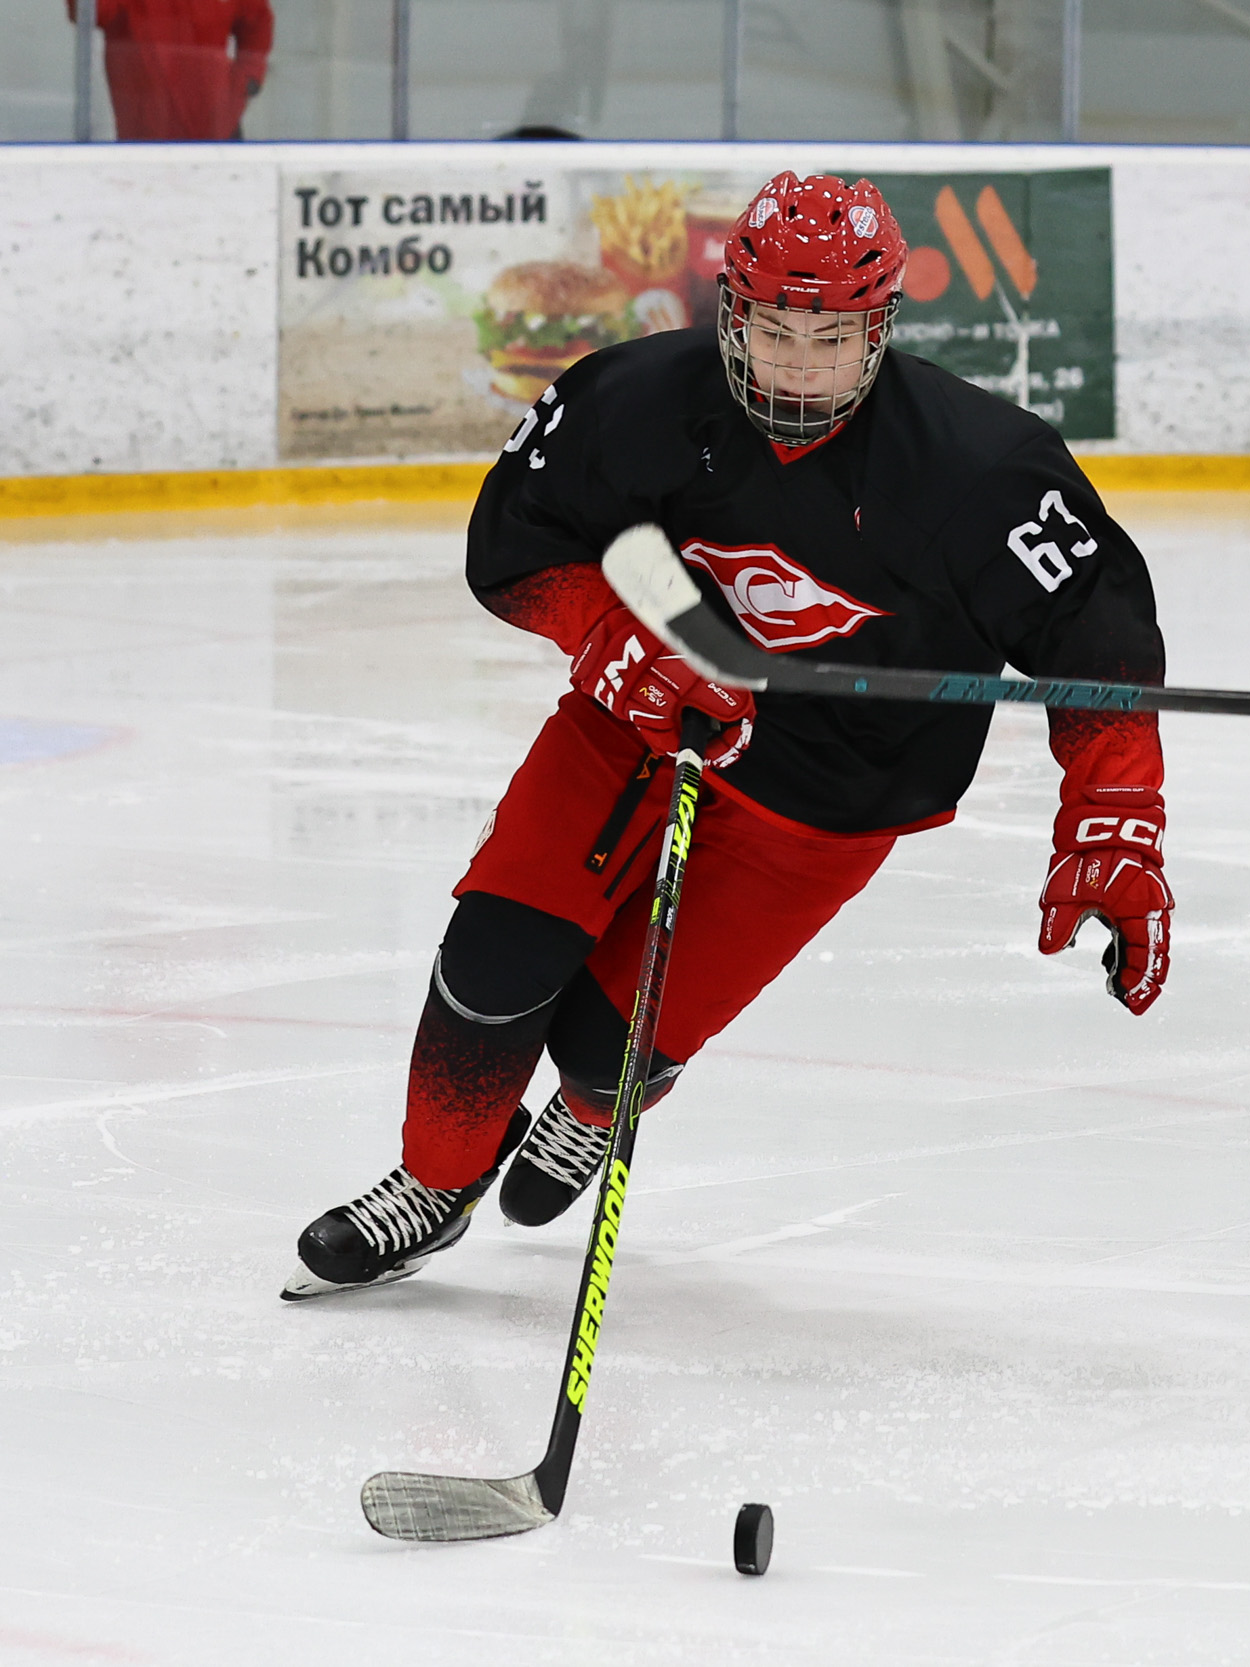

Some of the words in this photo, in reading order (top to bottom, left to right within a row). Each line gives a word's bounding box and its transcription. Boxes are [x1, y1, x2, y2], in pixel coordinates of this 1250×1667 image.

[295, 188, 368, 228] Тот
[382, 180, 548, 226] самый
[296, 236, 453, 278] Комбо
[781, 285, 820, 294] TRUE
[1007, 490, 1098, 592] 63
[707, 682, 737, 707] CCM
[566, 1159, 630, 1415] SHERWOOD
